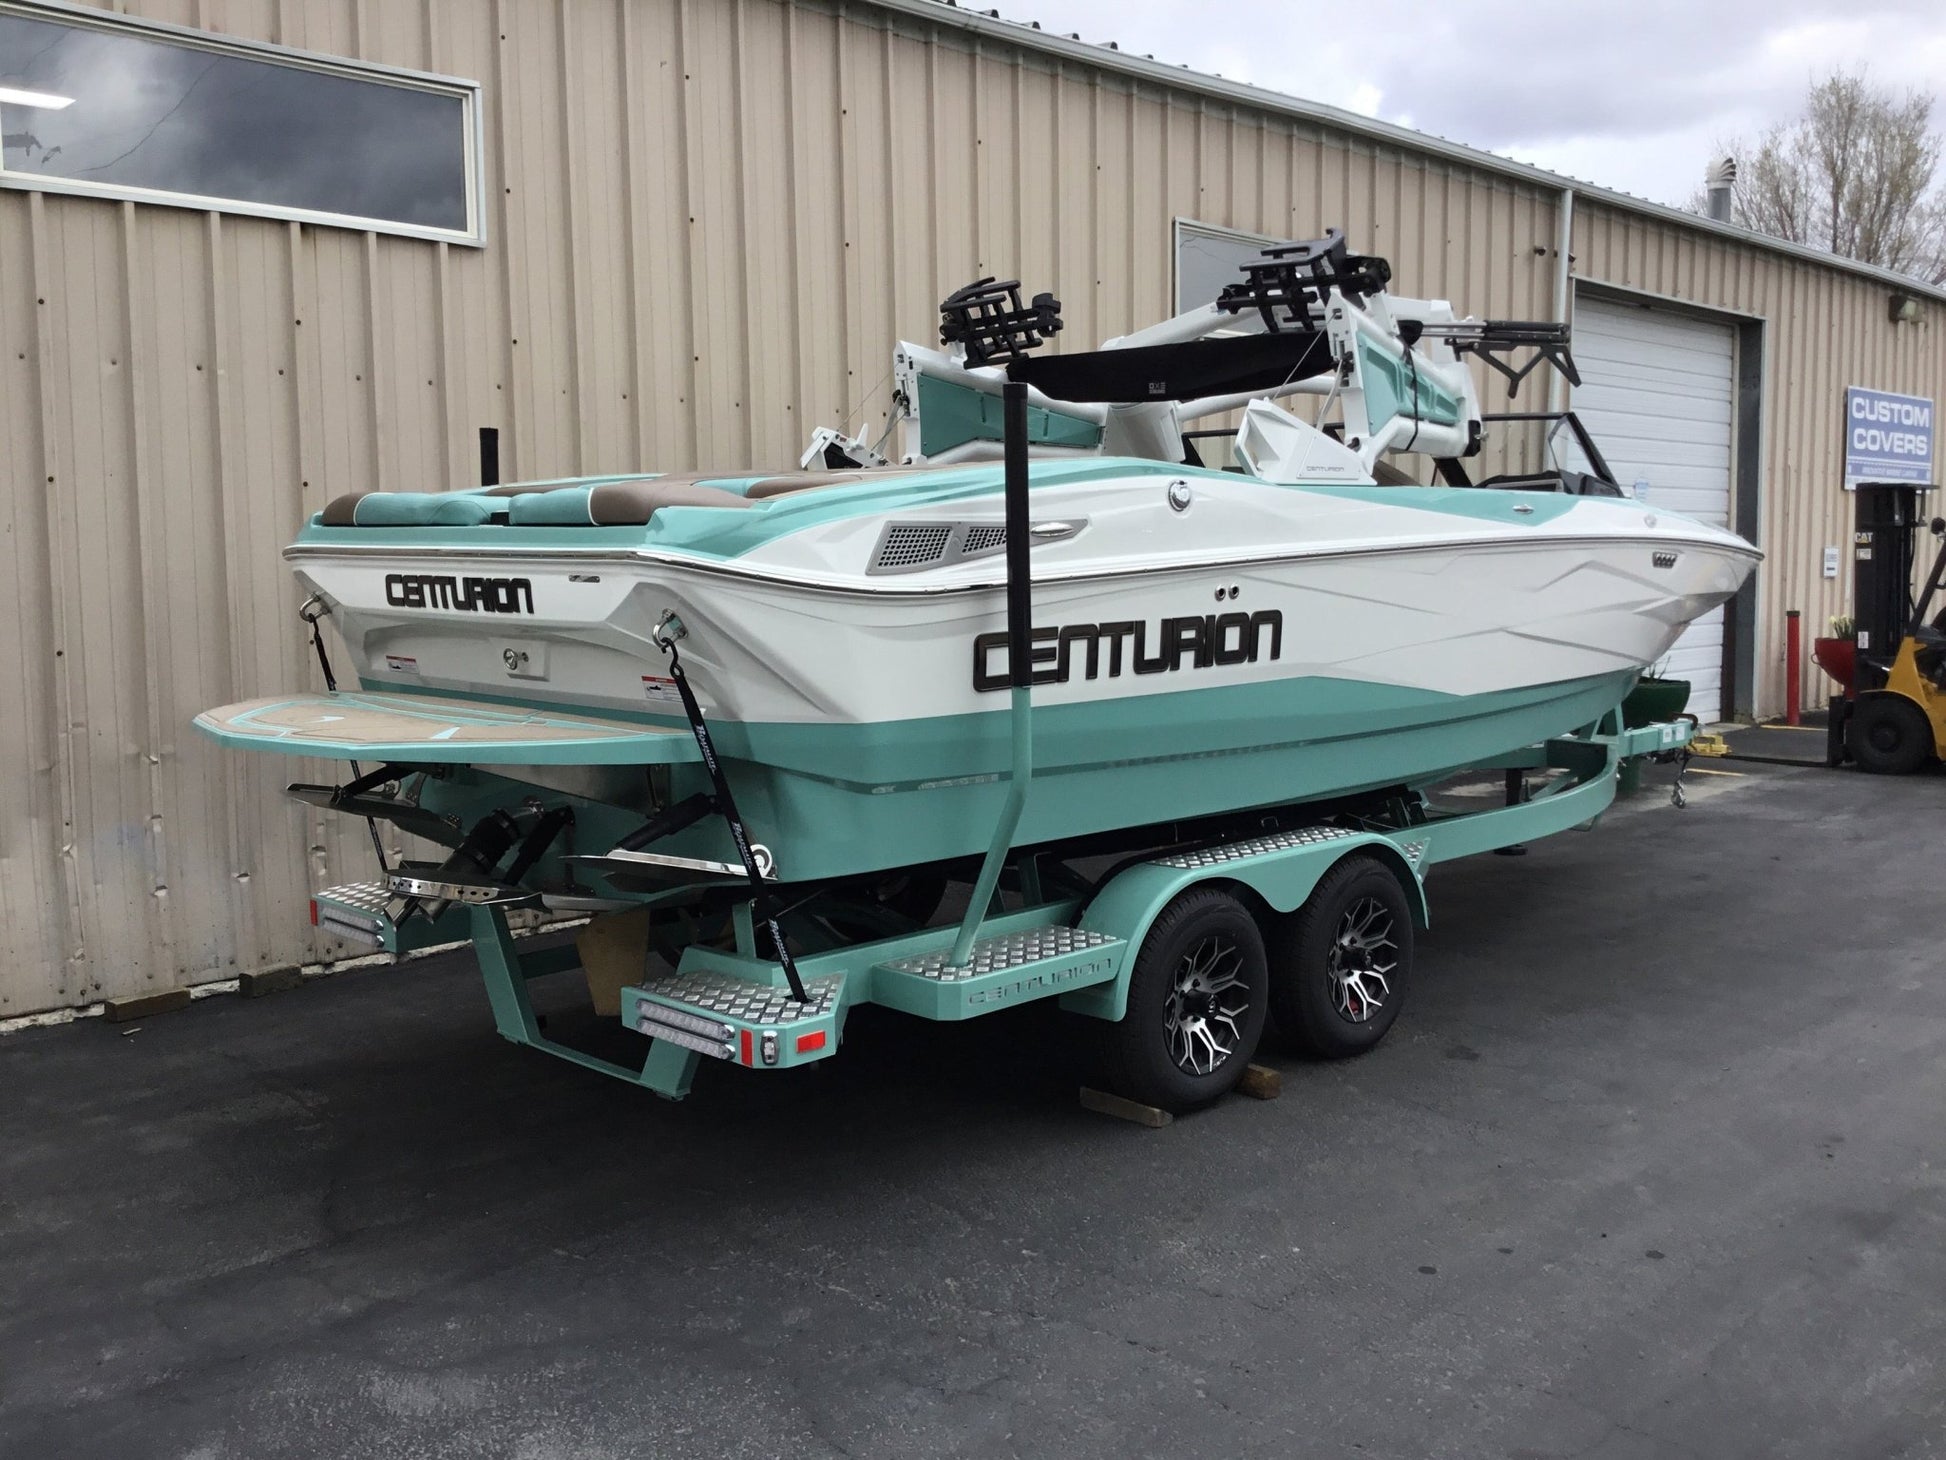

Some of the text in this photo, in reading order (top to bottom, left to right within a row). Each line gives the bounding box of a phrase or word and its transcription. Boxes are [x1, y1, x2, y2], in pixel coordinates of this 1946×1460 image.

[1852, 397, 1929, 428] CUSTOM
[1853, 428, 1928, 456] COVERS
[1855, 532, 1873, 543] CAT
[385, 574, 534, 614] CENTURION
[973, 609, 1283, 692] CENTURION
[968, 958, 1112, 1005] CENTURION
